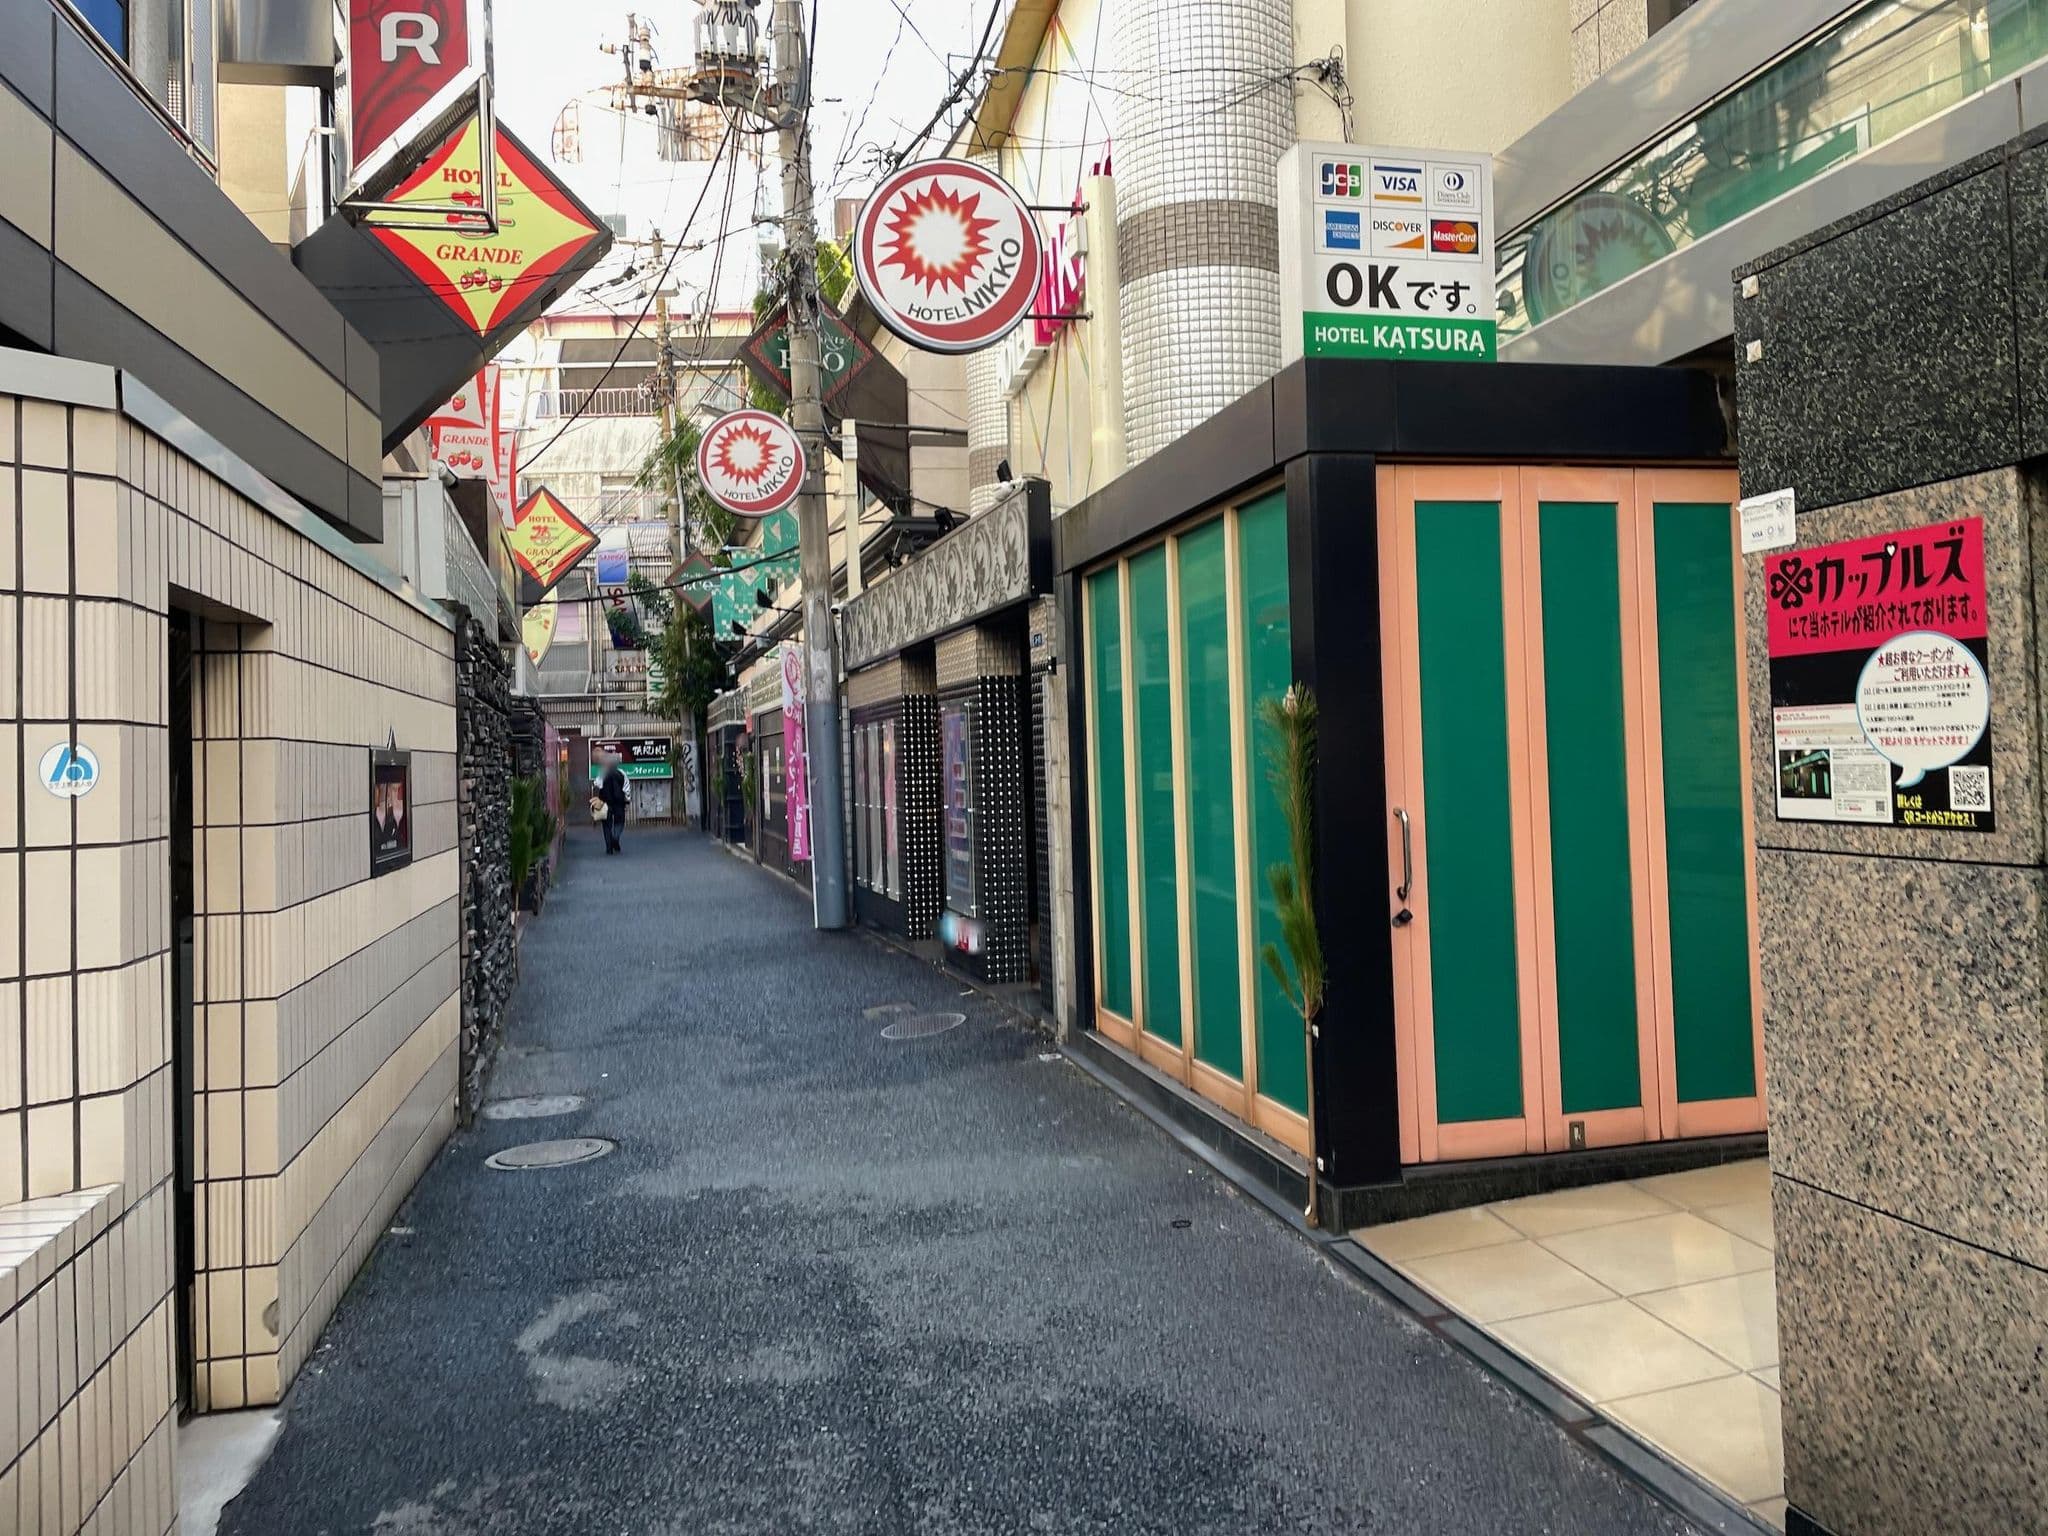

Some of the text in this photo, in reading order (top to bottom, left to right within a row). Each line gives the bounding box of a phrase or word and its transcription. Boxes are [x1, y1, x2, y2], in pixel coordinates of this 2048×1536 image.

[380, 11, 441, 65] R
[443, 167, 512, 187] HOTL
[1322, 174, 1361, 189] JCB
[1382, 176, 1417, 192] VISA
[1373, 220, 1422, 233] DISCOVER
[1433, 231, 1476, 242] MasterCard
[436, 243, 523, 265] GRANDE
[907, 303, 967, 322] HOTEL
[962, 238, 1021, 316] NIKKO
[1315, 325, 1485, 352] HOTEL KATSURA
[724, 455, 793, 500] HOTEL NIKKO
[528, 515, 558, 524] HOTEL
[1815, 526, 1970, 604] カップルズ
[1788, 592, 1979, 639] にて当ホテルが紹介されております。
